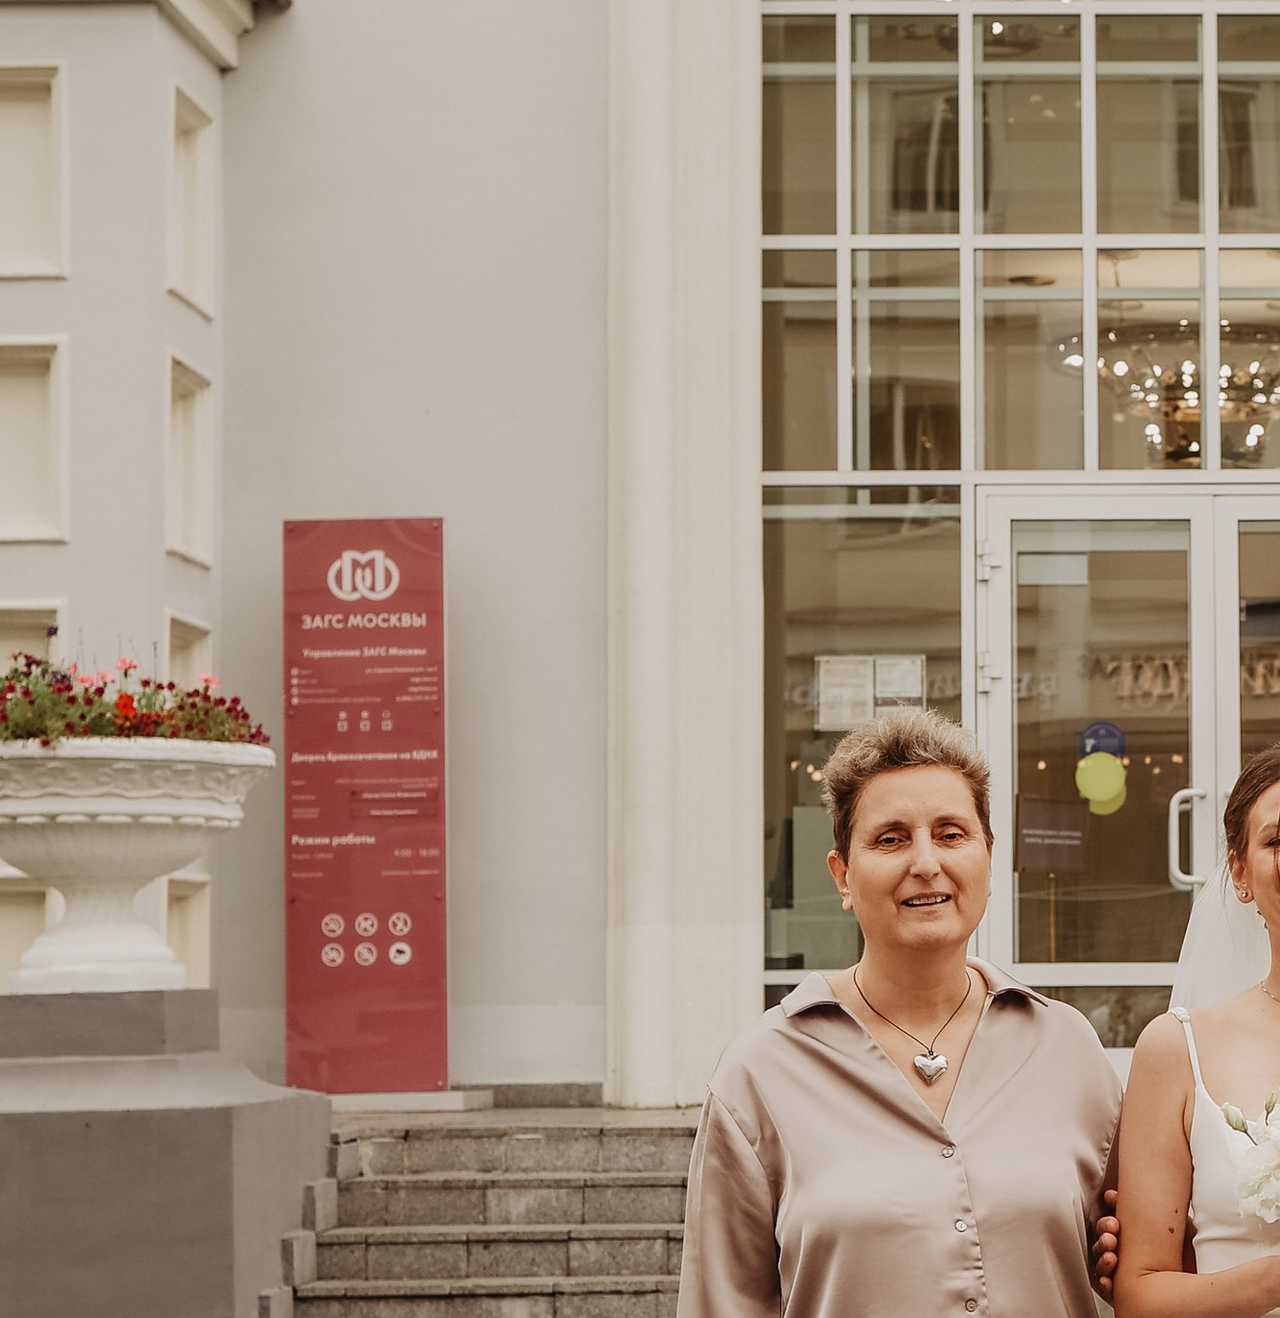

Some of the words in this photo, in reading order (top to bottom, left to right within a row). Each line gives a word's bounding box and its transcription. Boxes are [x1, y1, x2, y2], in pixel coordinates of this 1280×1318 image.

[301, 613, 345, 630] ЗАГС
[347, 611, 427, 629] МОСКВЫ
[302, 647, 361, 660] Управление
[362, 646, 388, 658] ЗАГС
[389, 646, 427, 658] Москвы
[291, 752, 326, 764] Дворец
[326, 750, 398, 764] бракосочетания
[399, 752, 411, 760] на
[291, 834, 331, 846] Режим
[331, 833, 377, 848] работы
